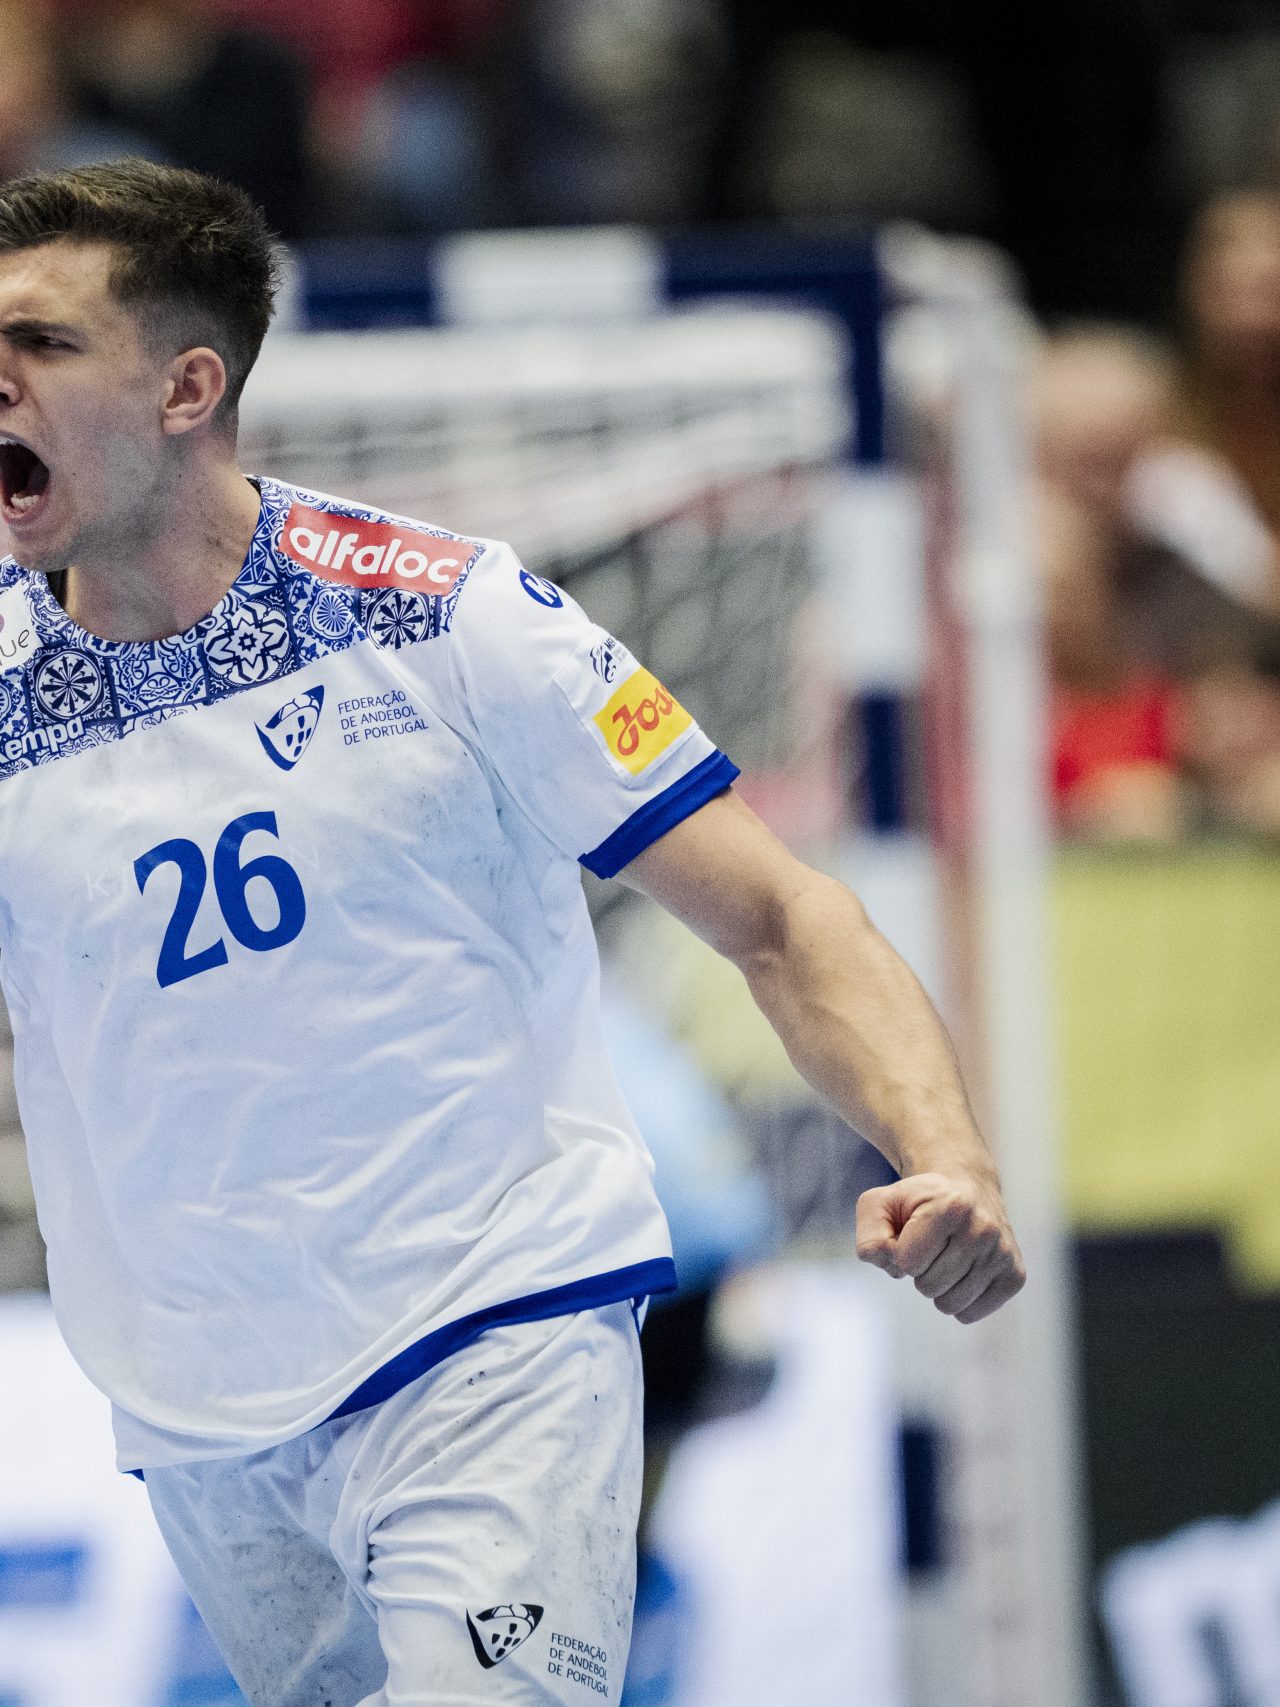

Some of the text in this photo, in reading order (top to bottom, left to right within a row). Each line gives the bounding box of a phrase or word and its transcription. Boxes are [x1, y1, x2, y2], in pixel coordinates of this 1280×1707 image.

[289, 527, 459, 584] alfaloc
[337, 690, 407, 715] FEDERAÇÃO
[340, 705, 418, 730] DE ANDEBOL
[612, 683, 678, 756] Jos
[343, 718, 429, 745] DE PORTUGAL
[133, 811, 307, 989] 26
[549, 1647, 608, 1681] DE ANDEBOL
[551, 1632, 607, 1663] FEDERAÇÃO
[547, 1661, 609, 1698] DE PORTUGAL
